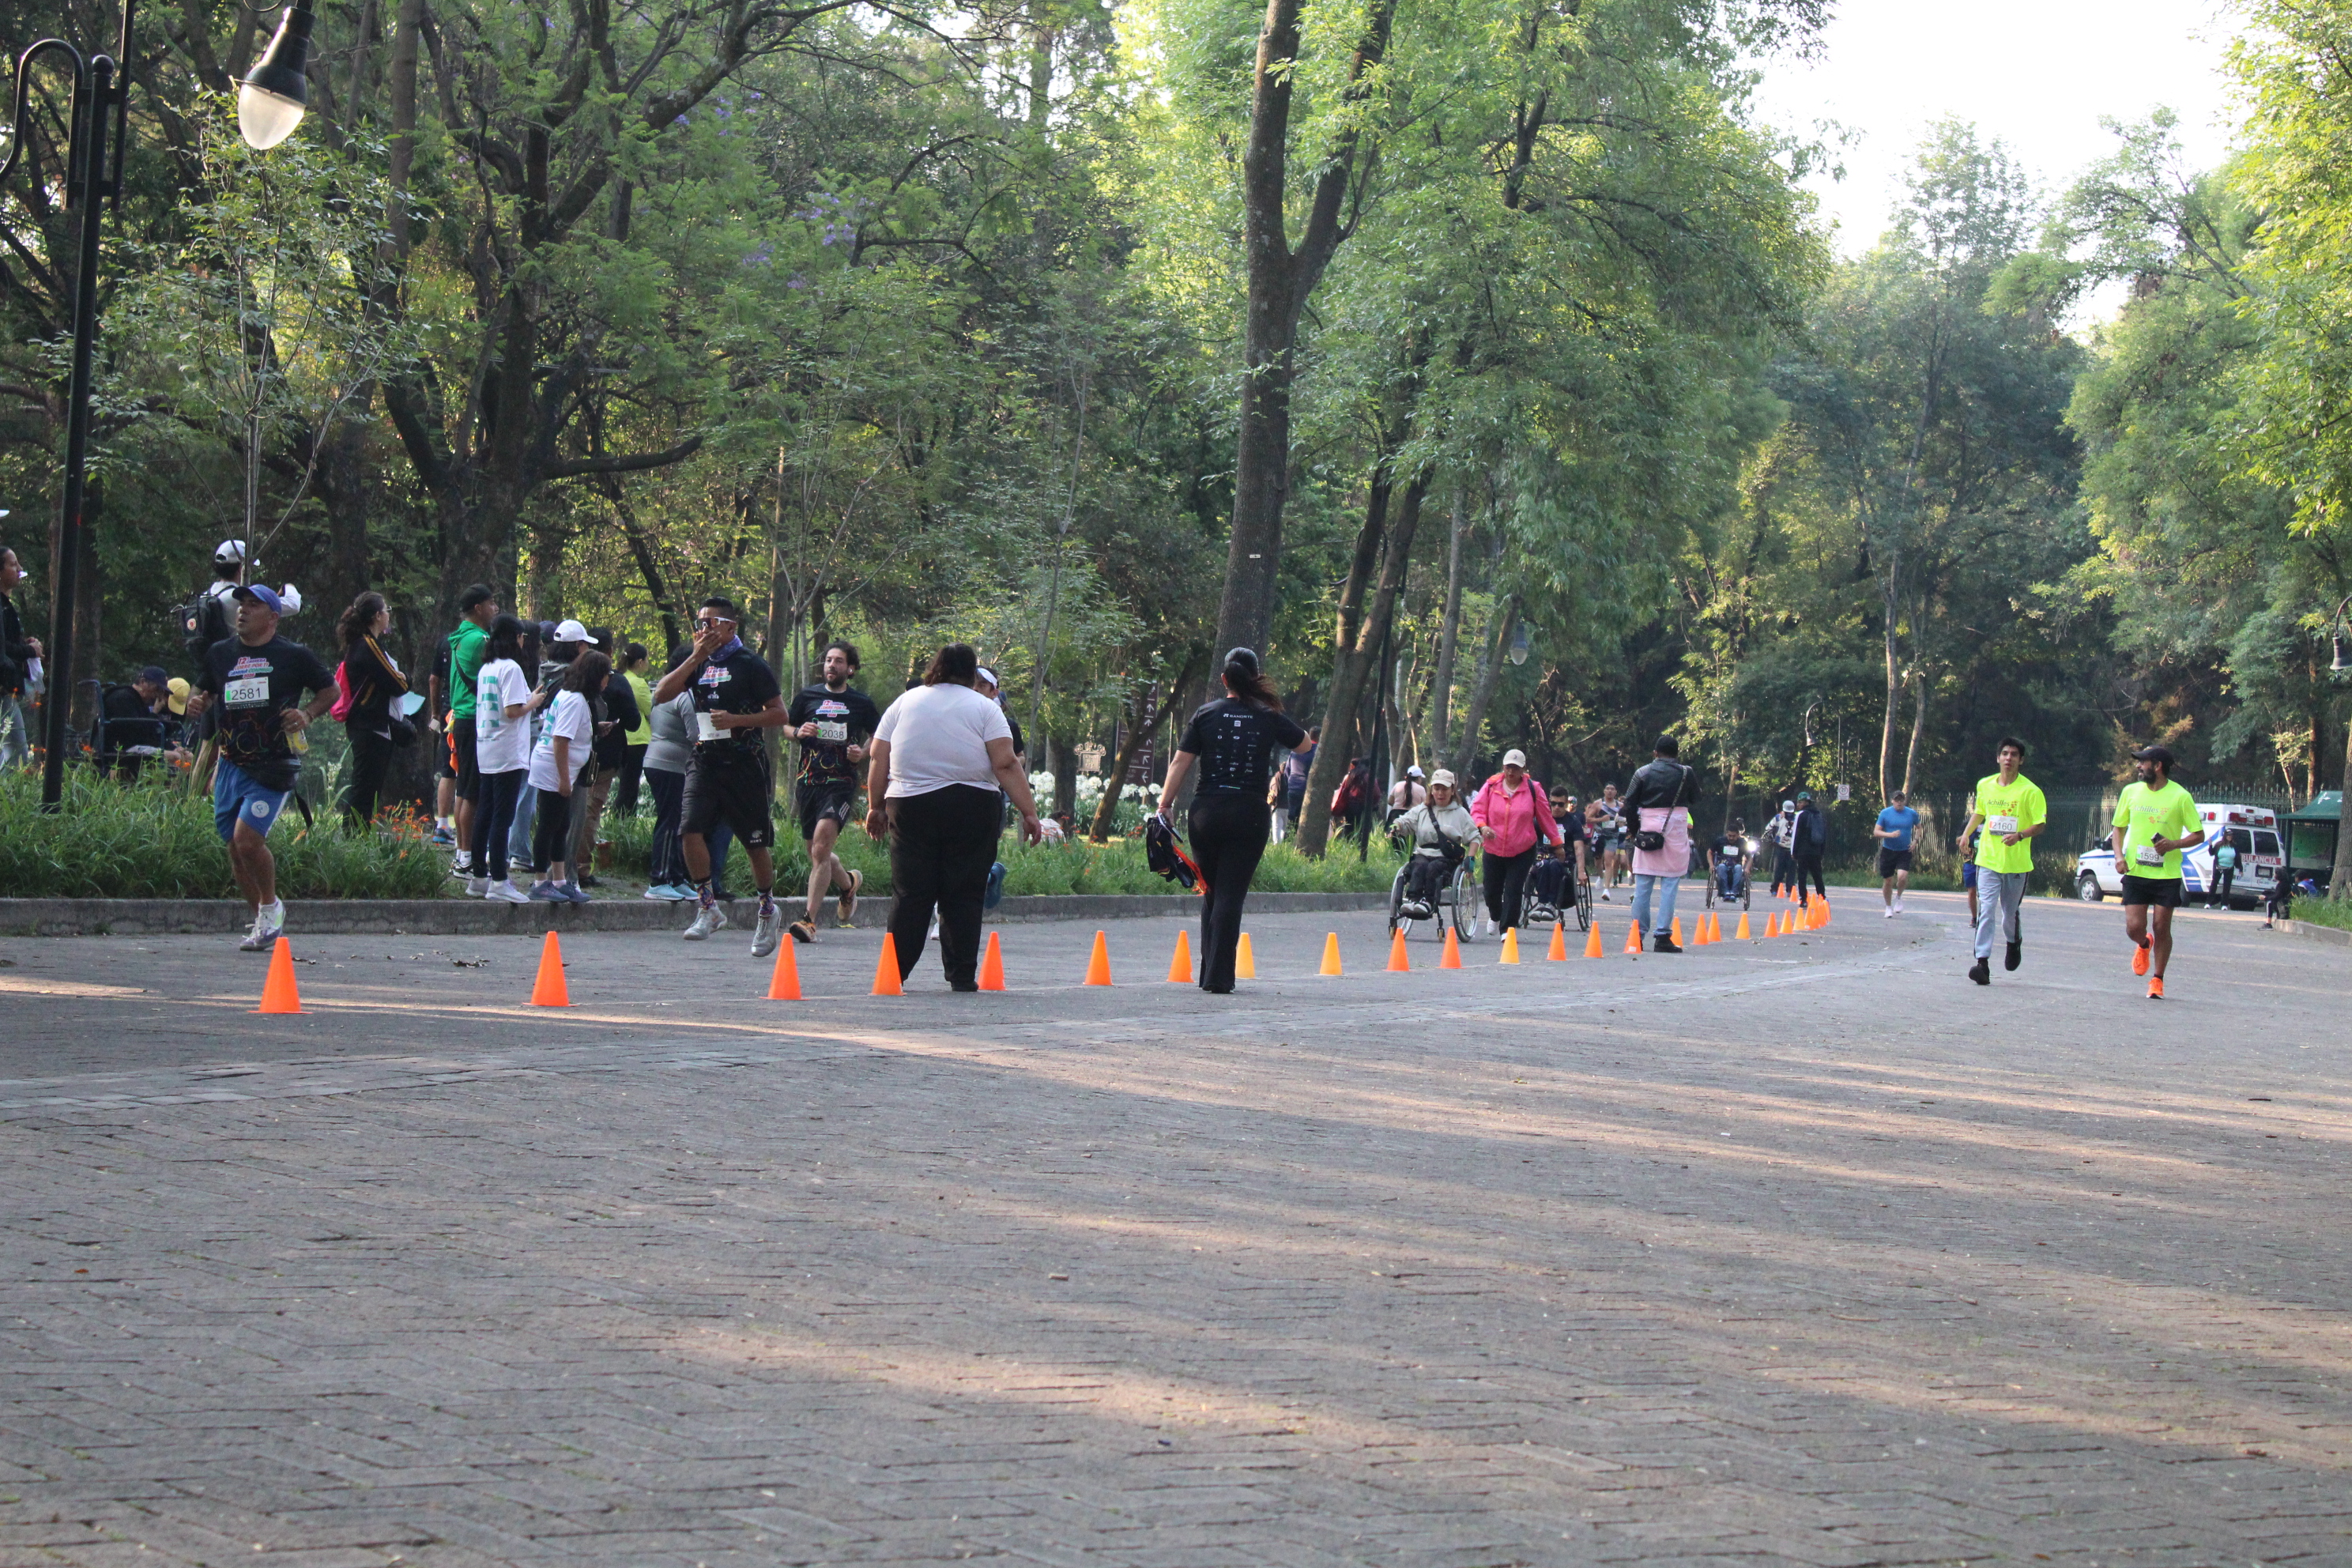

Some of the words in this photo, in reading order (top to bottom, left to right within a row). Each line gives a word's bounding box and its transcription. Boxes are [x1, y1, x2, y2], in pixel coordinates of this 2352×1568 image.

[232, 688, 261, 700] 2581
[822, 729, 844, 740] 2038
[1992, 822, 2012, 831] 2160
[2140, 852, 2160, 861] 1599
[2241, 854, 2277, 864] BULANCIA
